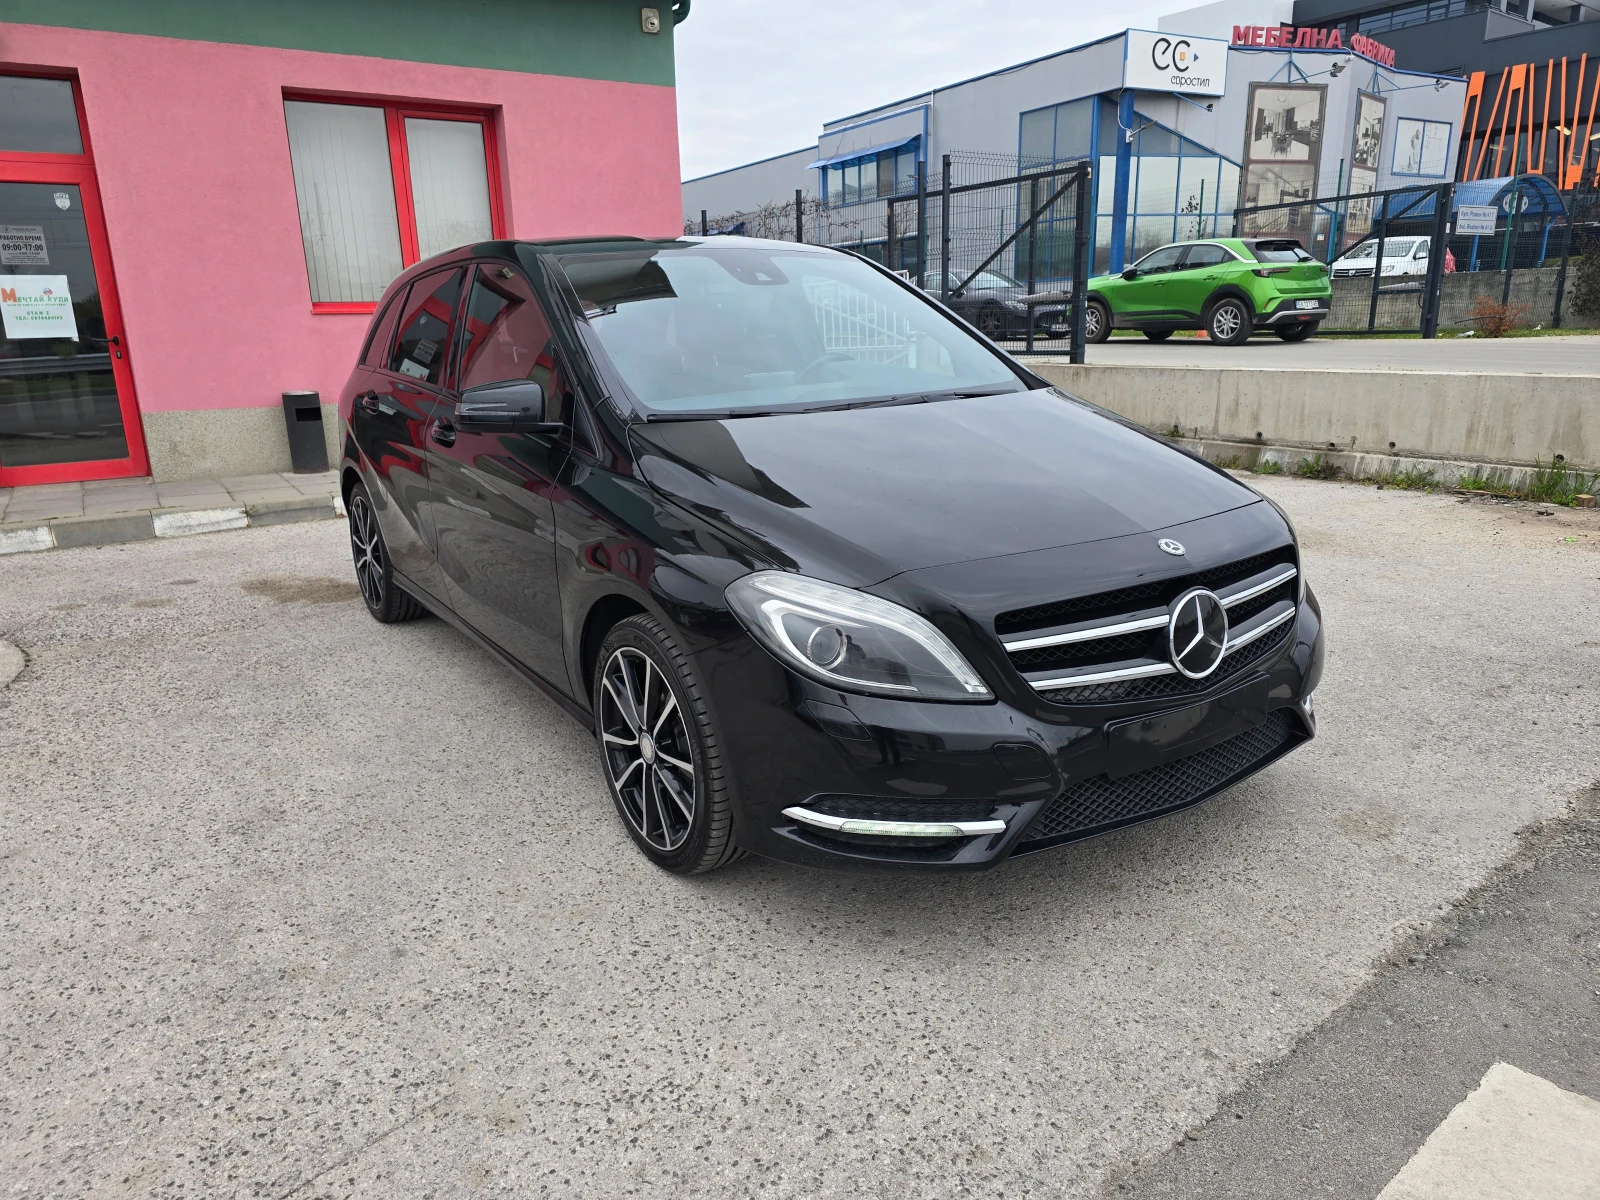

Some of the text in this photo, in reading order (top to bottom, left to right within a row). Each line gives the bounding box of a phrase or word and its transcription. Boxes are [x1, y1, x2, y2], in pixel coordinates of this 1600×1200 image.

[1231, 25, 1396, 68] МЕБЕЛНА ФАБРИКА
[2, 243, 44, 251] 09:00-17:00
[47, 295, 69, 303] КУПИ
